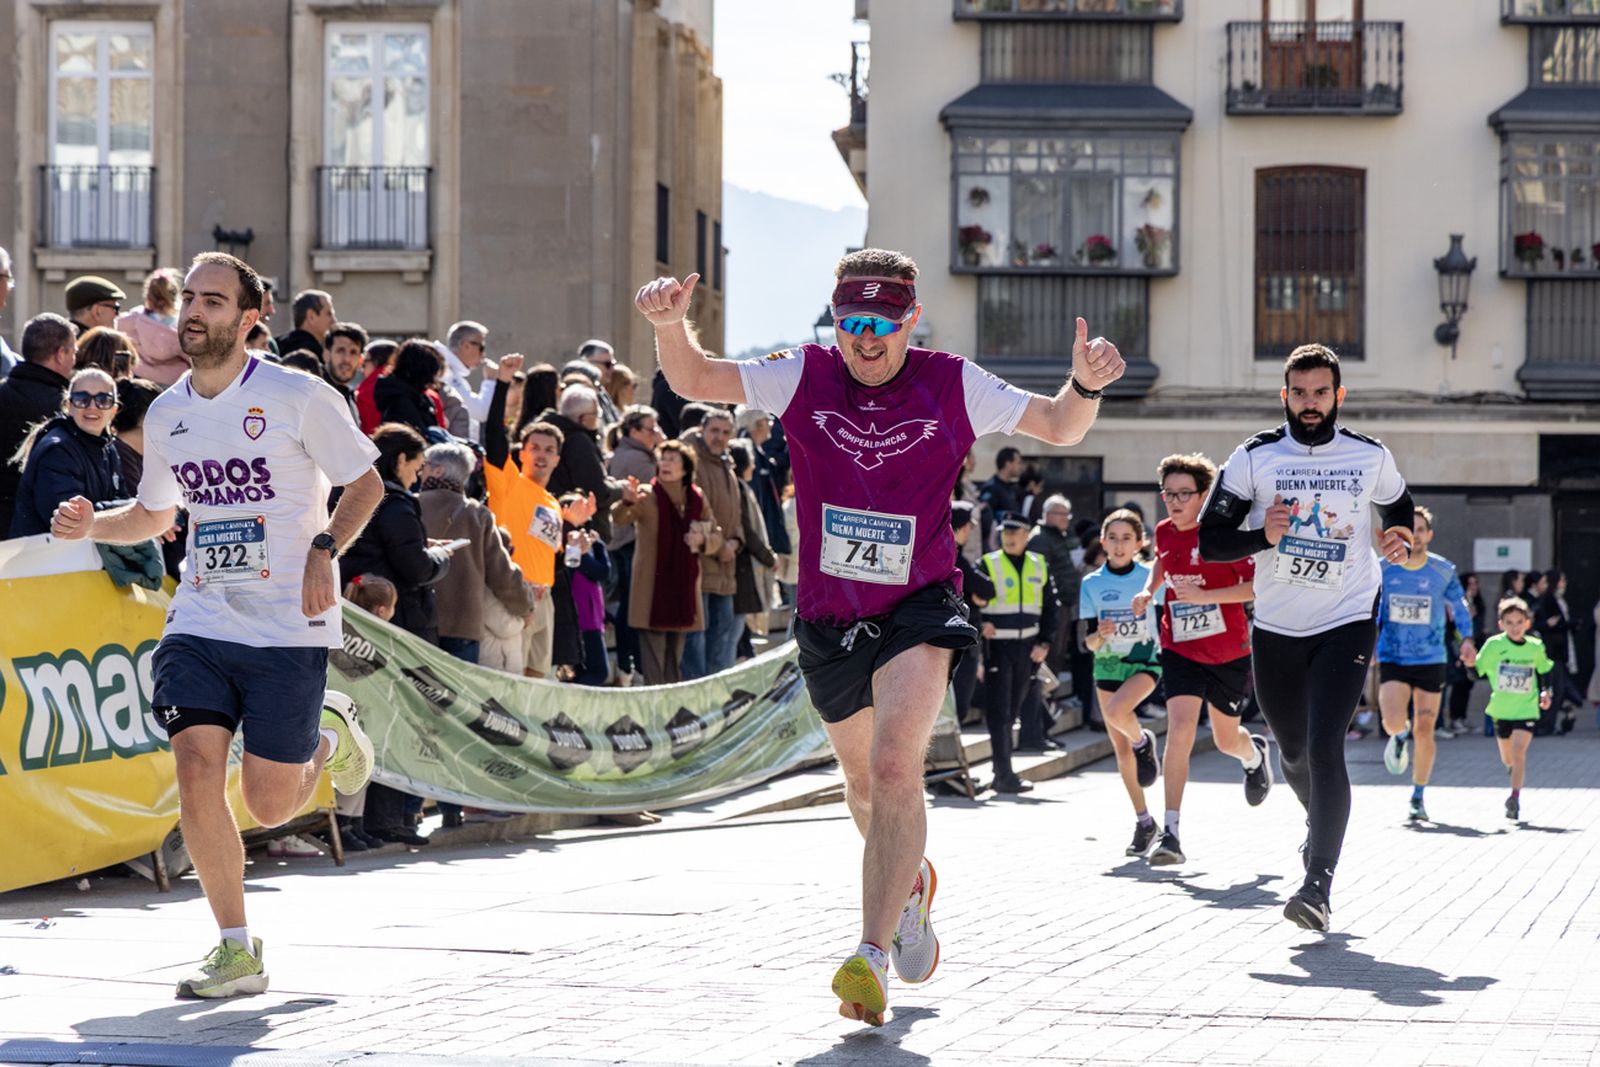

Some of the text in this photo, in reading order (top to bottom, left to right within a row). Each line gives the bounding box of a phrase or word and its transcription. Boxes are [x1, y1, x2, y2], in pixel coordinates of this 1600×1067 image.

[1276, 480, 1346, 491] BUENA MUERTE
[183, 484, 276, 506] MAMOS
[216, 531, 242, 543] MUERTE
[831, 522, 886, 540] BUENA MUERTE
[205, 544, 248, 570] 322
[845, 540, 879, 567] 74
[1304, 548, 1328, 559] MUERTE
[1290, 557, 1329, 579] 579
[1114, 621, 1139, 637] 02
[1181, 613, 1210, 631] 722
